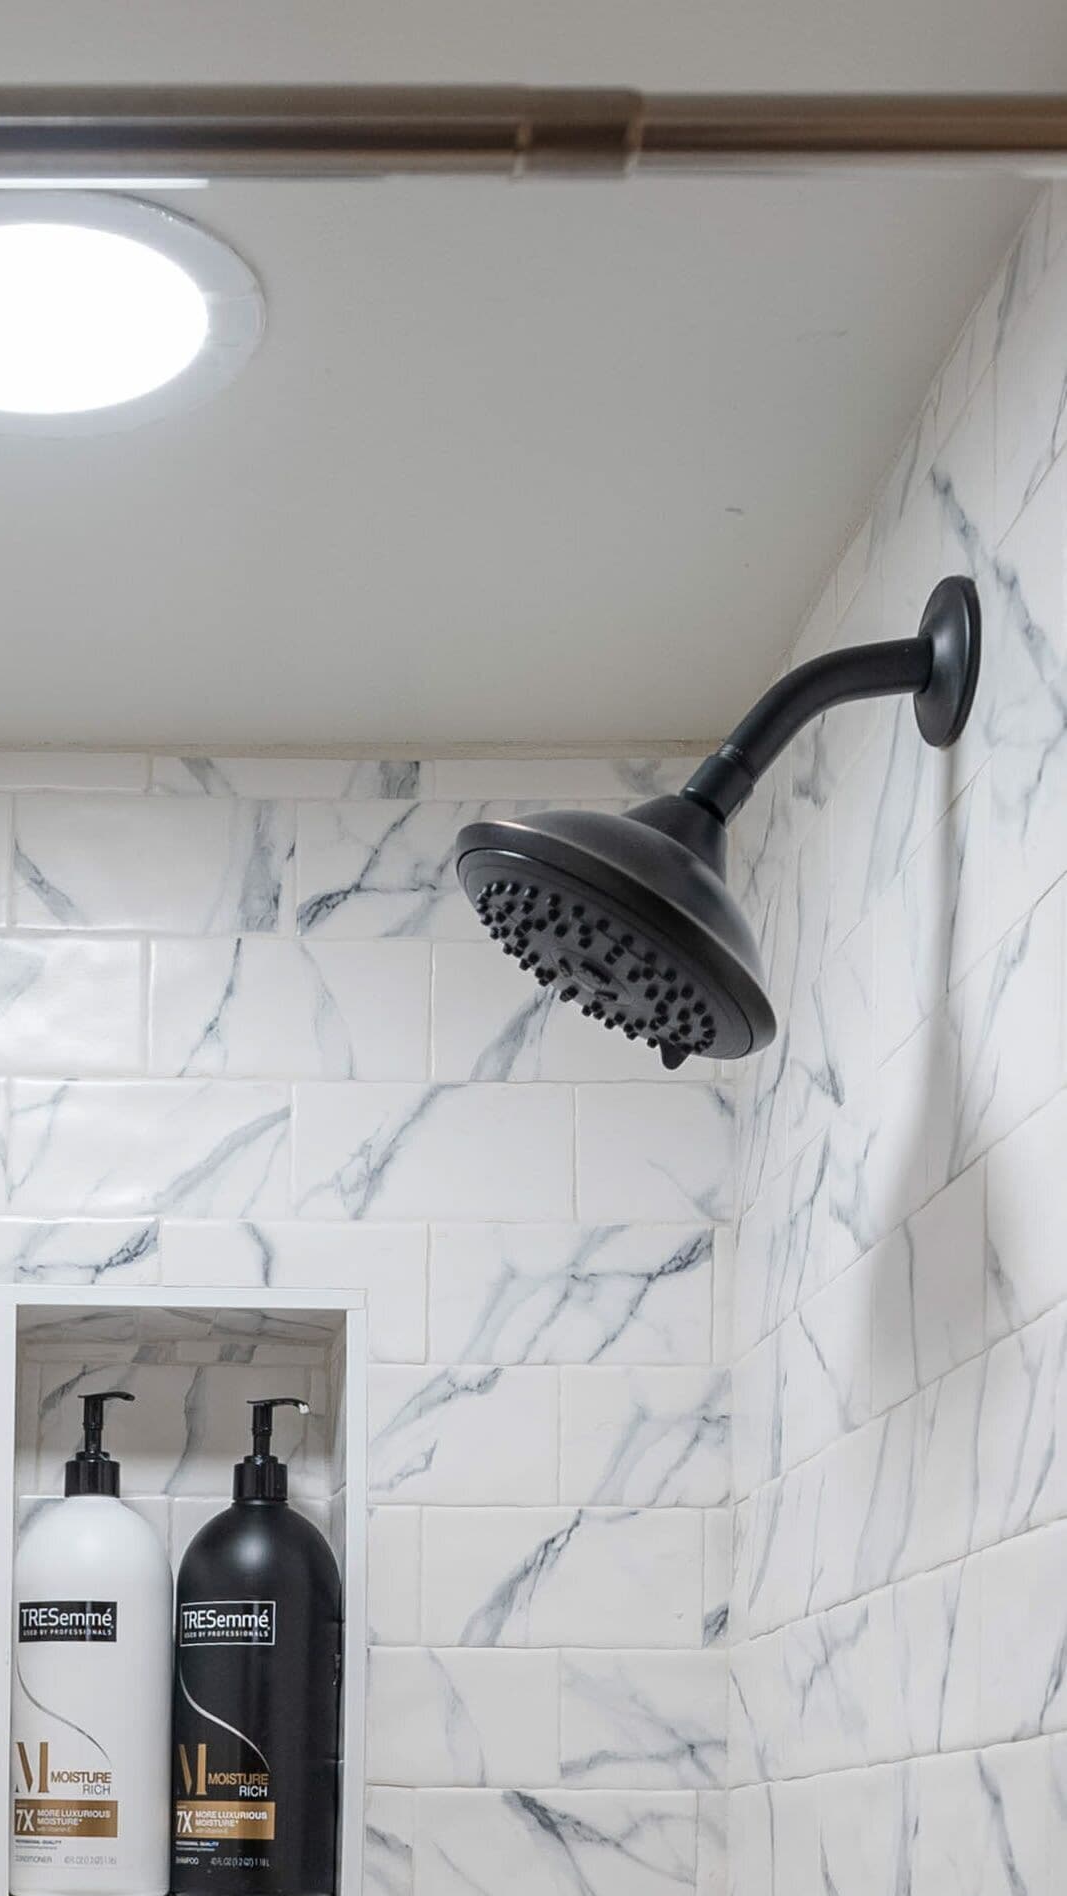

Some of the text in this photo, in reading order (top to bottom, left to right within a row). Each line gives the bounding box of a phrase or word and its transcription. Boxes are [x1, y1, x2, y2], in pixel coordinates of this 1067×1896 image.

[21, 1607, 113, 1627] TRESemmé
[183, 1609, 270, 1629] TRESemmé
[49, 1628, 113, 1636] PROFESSIONALS
[207, 1630, 269, 1638] PROFESSIONALS
[50, 1771, 112, 1784] MOISTURE
[208, 1773, 270, 1786] MOISTURE
[82, 1784, 112, 1795] RICH
[239, 1785, 268, 1797] RICH
[16, 1808, 35, 1832] 7X
[37, 1809, 112, 1819] MORE LUXURIOUS
[195, 1810, 268, 1820] MORE LUXURIOUS
[176, 1810, 193, 1833] 7X
